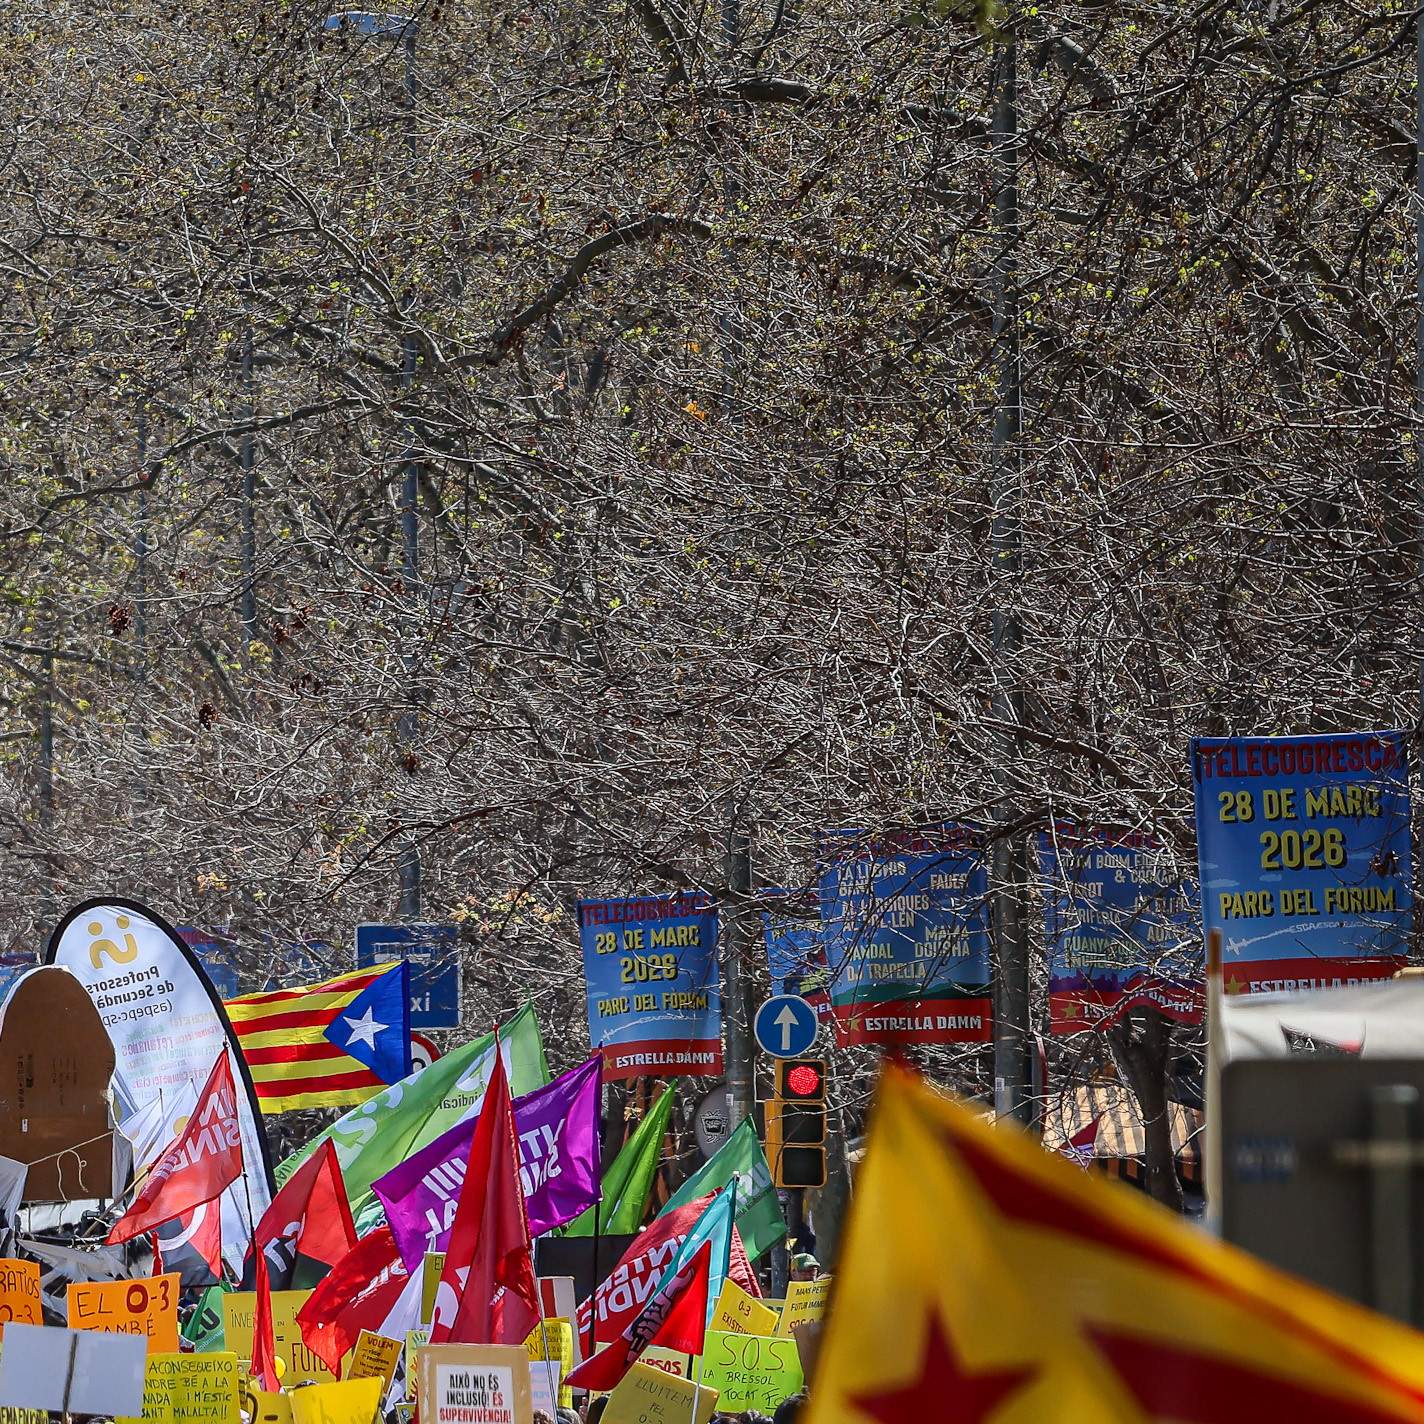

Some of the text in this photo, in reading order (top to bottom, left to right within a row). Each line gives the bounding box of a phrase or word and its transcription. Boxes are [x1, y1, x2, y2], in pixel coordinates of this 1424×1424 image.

[1219, 789, 1253, 823] 28
[1263, 787, 1297, 820] DE
[1260, 828, 1347, 870] 2026
[1218, 889, 1273, 919] PARC
[1279, 890, 1319, 916] DEL
[595, 931, 618, 954] 28
[409, 990, 431, 1012] xi
[598, 996, 630, 1017] PARC
[634, 993, 659, 1012] DEL
[865, 1015, 982, 1032] ESTRELLA DAMM
[616, 1051, 676, 1069] ESTRELLA
[77, 1290, 113, 1318] EL
[145, 1378, 176, 1391] NDRE
[202, 1377, 209, 1388] A
[215, 1376, 229, 1388] LA
[473, 1374, 486, 1390] NO
[488, 1373, 500, 1390] ÉS
[703, 1368, 775, 1386] LA BRESSOL
[723, 1388, 757, 1402] TOCAT
